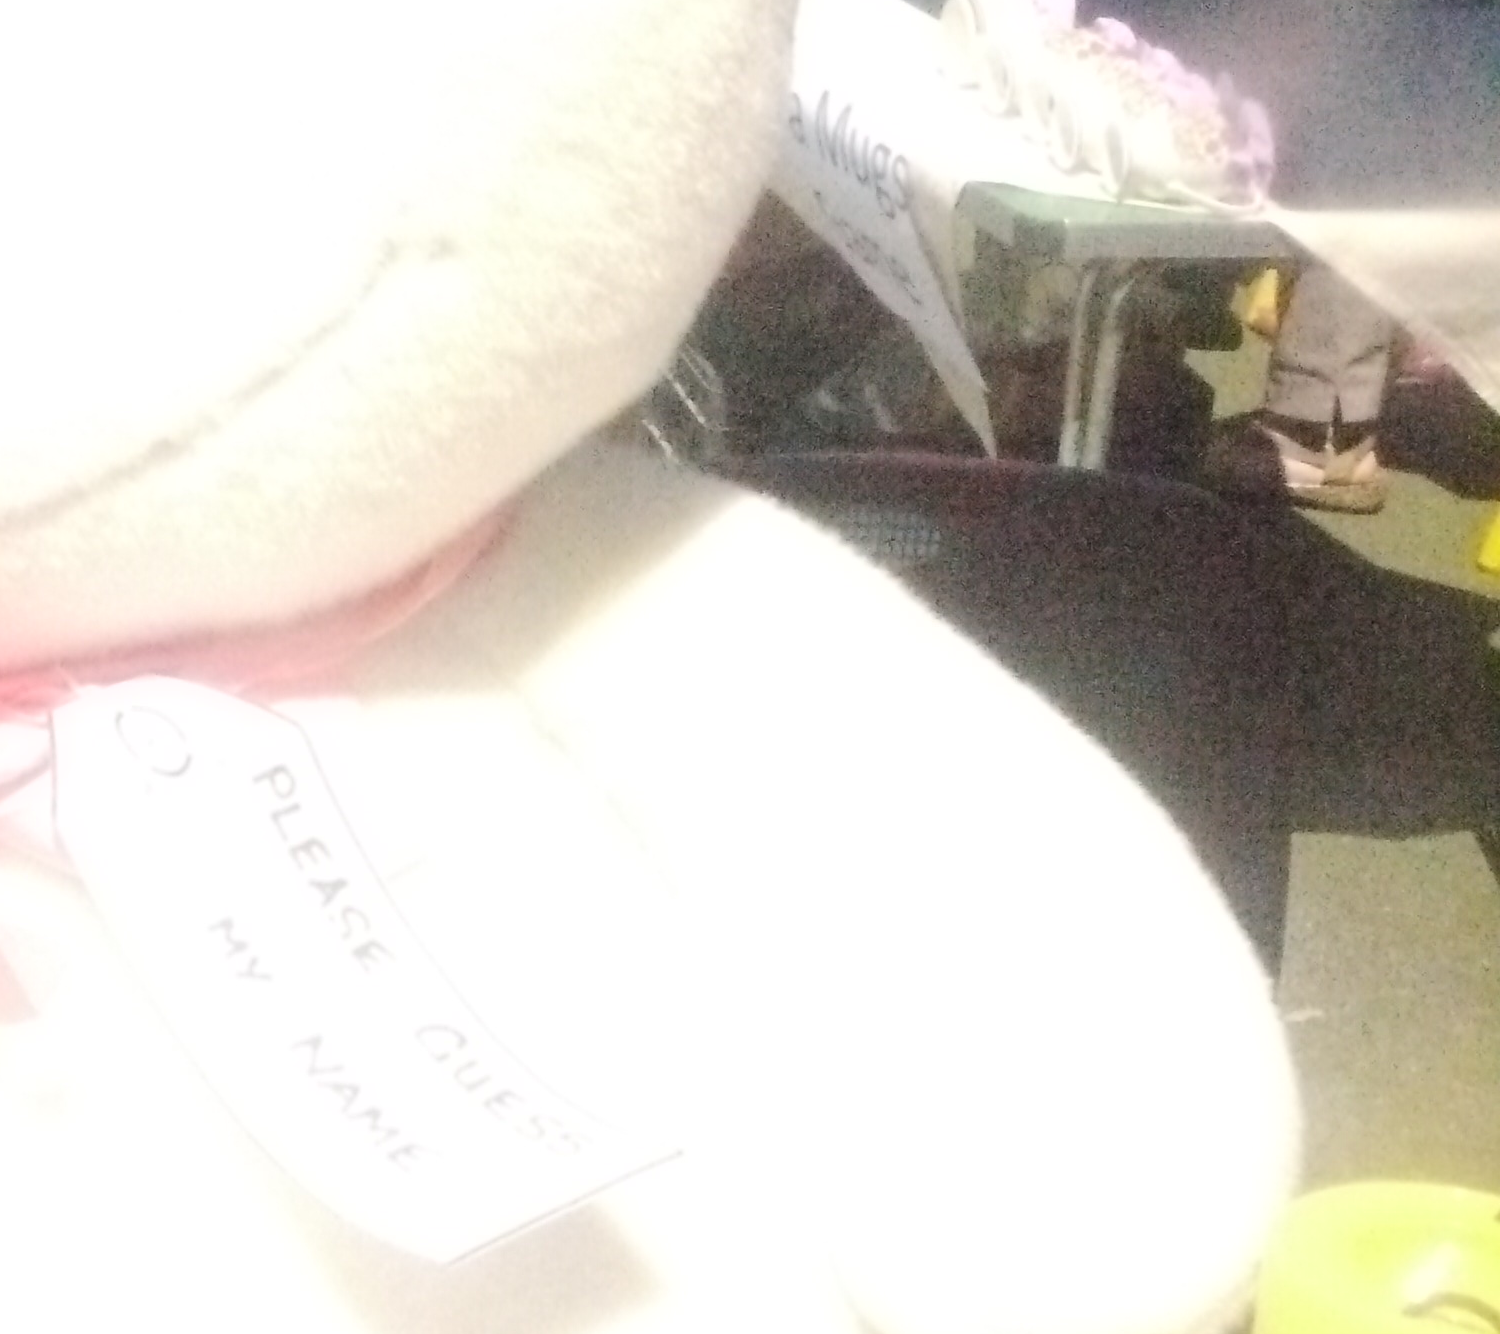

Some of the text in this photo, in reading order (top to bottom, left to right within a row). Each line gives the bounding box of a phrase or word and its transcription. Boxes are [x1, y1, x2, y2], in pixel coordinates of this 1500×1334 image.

[208, 916, 443, 1174] MY NAME
[252, 764, 594, 1159] PLEASE GUESS
